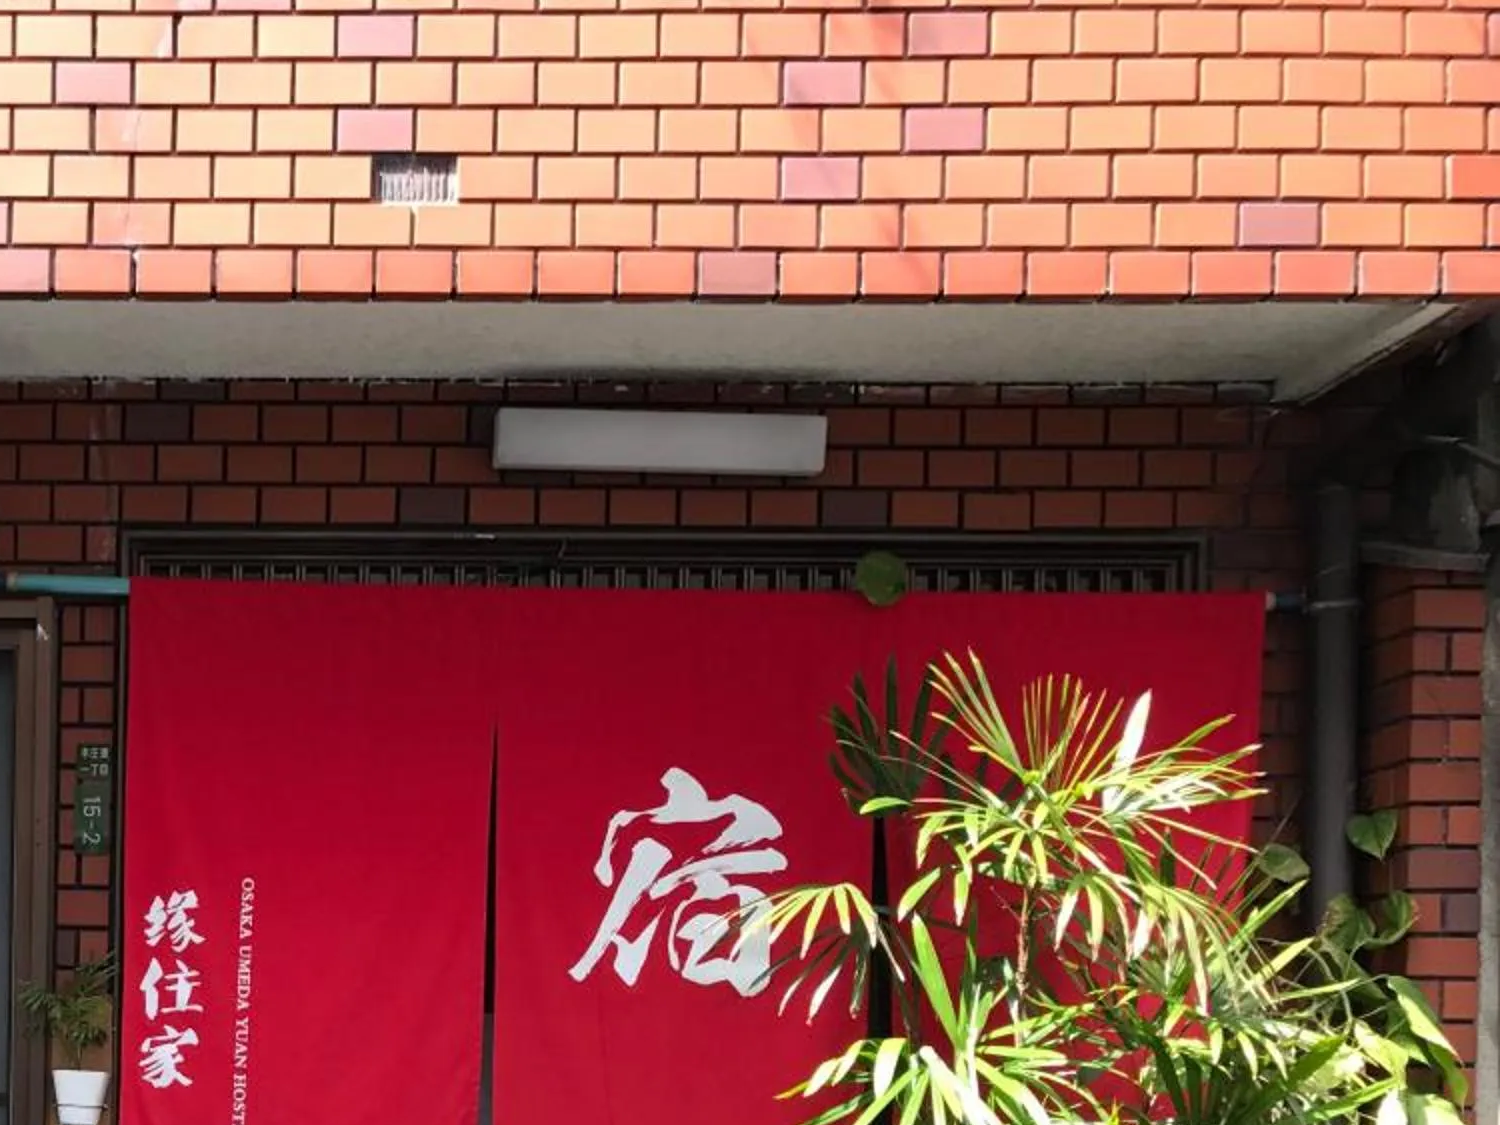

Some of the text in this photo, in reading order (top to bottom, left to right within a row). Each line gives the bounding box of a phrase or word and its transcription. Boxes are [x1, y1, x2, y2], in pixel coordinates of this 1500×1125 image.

[82, 796, 102, 844] 15-2
[239, 876, 255, 939] OSAKA
[568, 766, 788, 997] 宿
[236, 945, 252, 1011] UMEDA
[234, 1016, 250, 1069] YUAN
